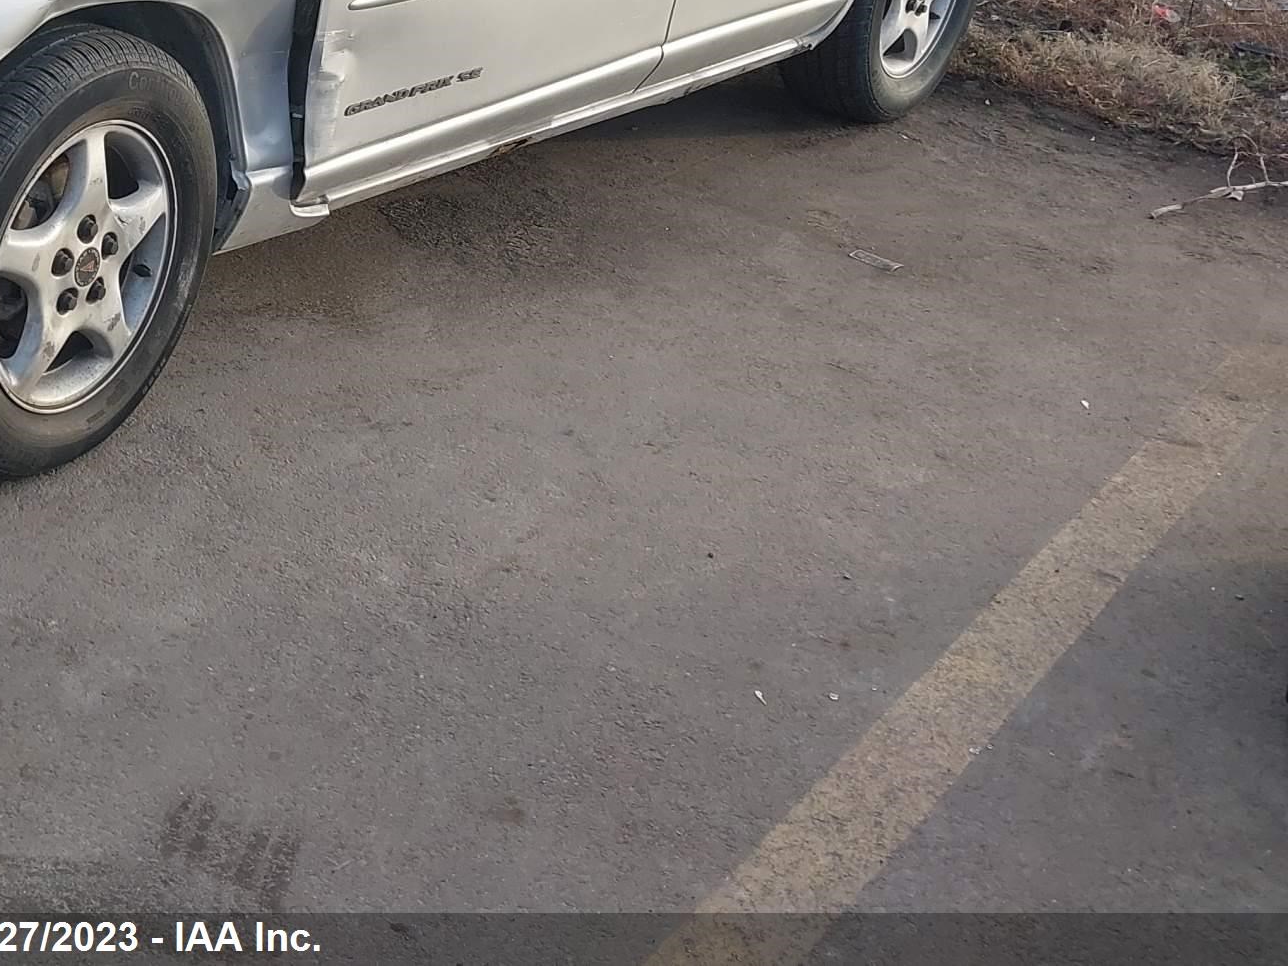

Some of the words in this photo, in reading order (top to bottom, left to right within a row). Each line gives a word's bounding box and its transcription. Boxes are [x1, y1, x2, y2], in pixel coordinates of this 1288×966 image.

[343, 87, 410, 117] GRAND
[408, 75, 454, 97] PRIX
[456, 66, 483, 82] SE
